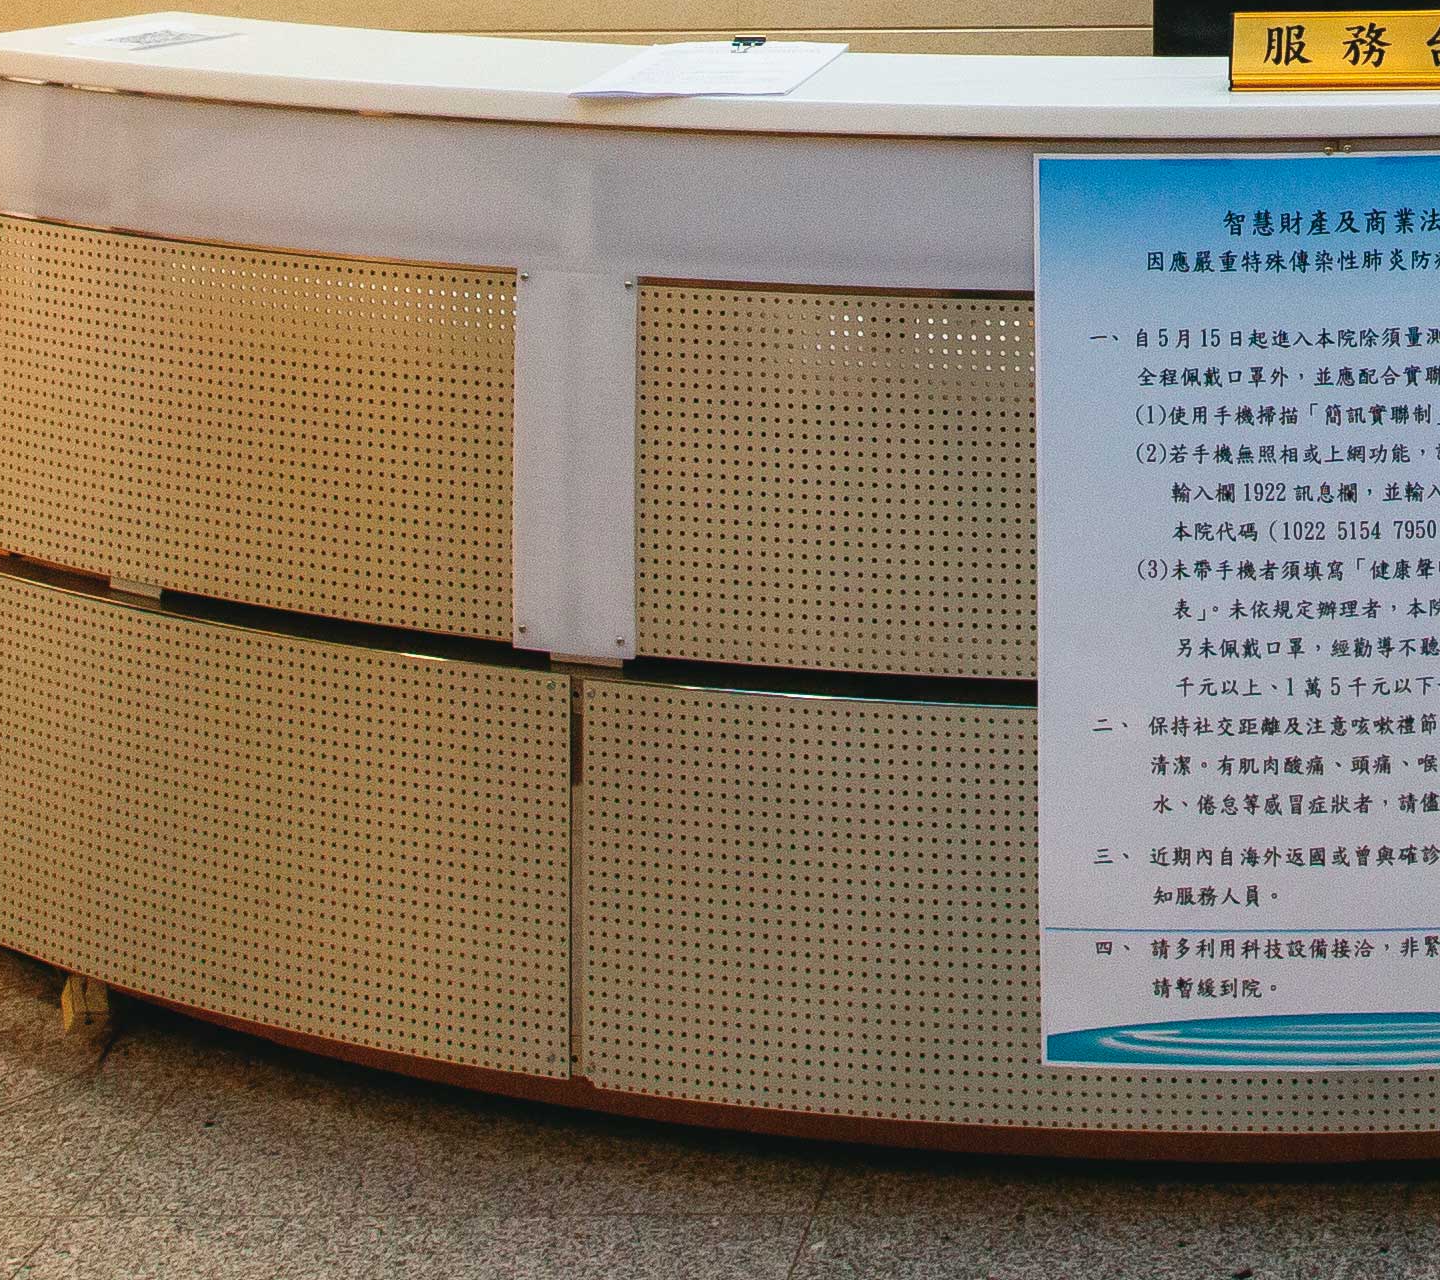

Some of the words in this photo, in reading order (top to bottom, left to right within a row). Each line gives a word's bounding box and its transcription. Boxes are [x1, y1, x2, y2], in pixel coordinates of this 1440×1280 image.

[1337, 520, 1382, 541] 5154
[1392, 519, 1437, 540] 7950
[1152, 884, 1278, 908] 知服務人員。
[1151, 976, 1277, 1000] 請暫緩到院。
